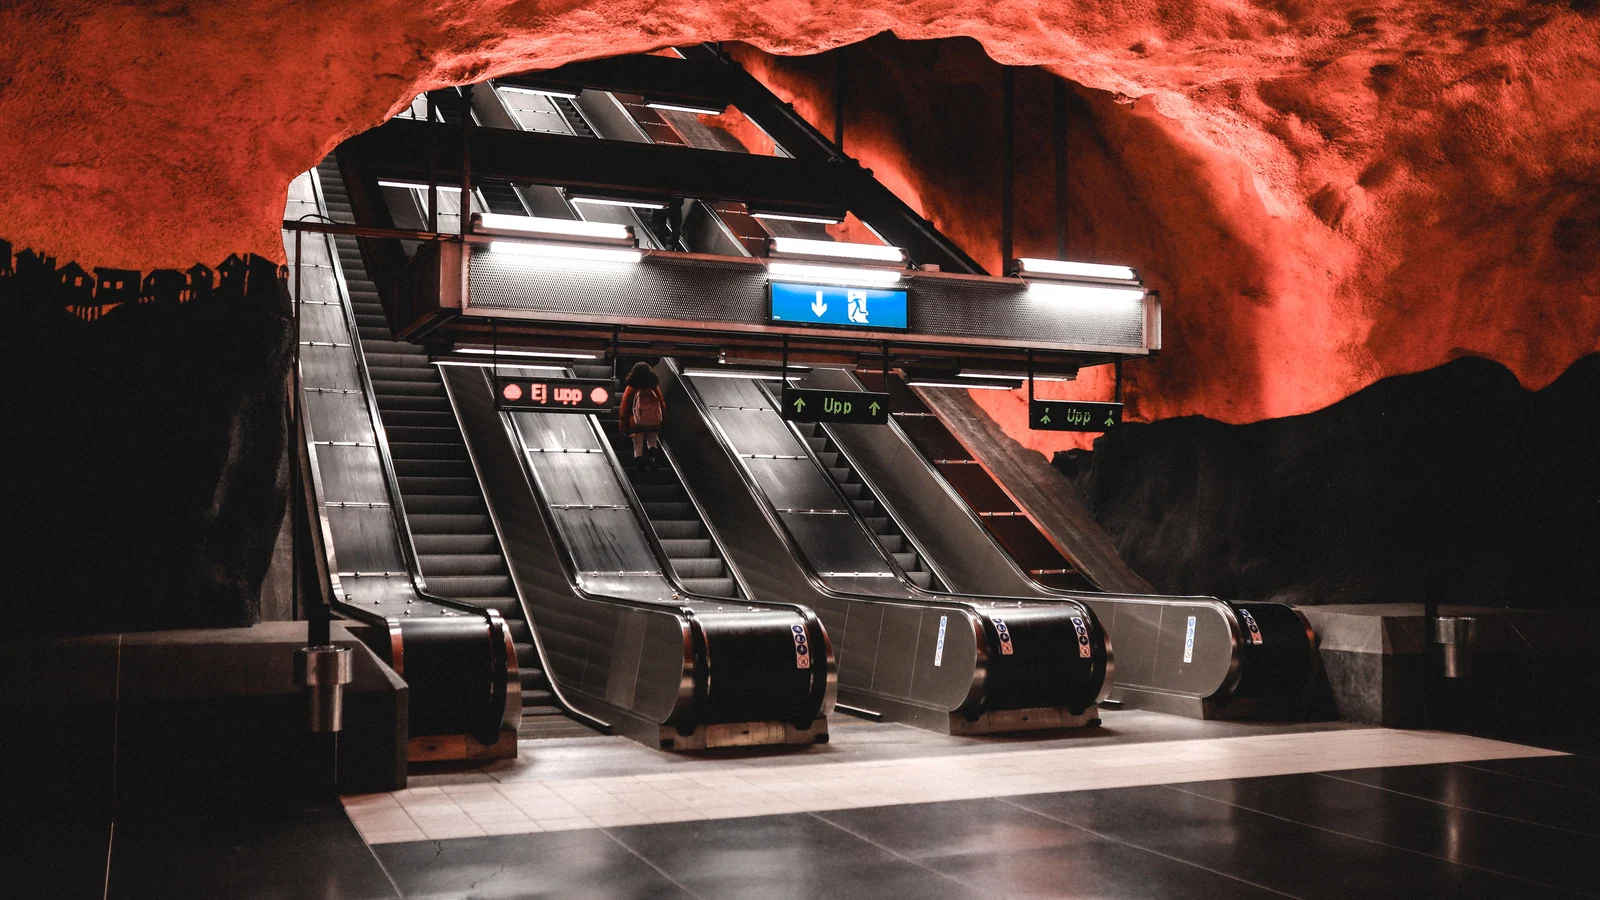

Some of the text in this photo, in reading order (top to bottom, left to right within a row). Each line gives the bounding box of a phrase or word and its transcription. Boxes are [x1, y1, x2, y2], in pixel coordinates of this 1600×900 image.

[531, 383, 583, 406] Ej upp
[823, 397, 852, 415] Upp
[1066, 408, 1091, 426] Upp
